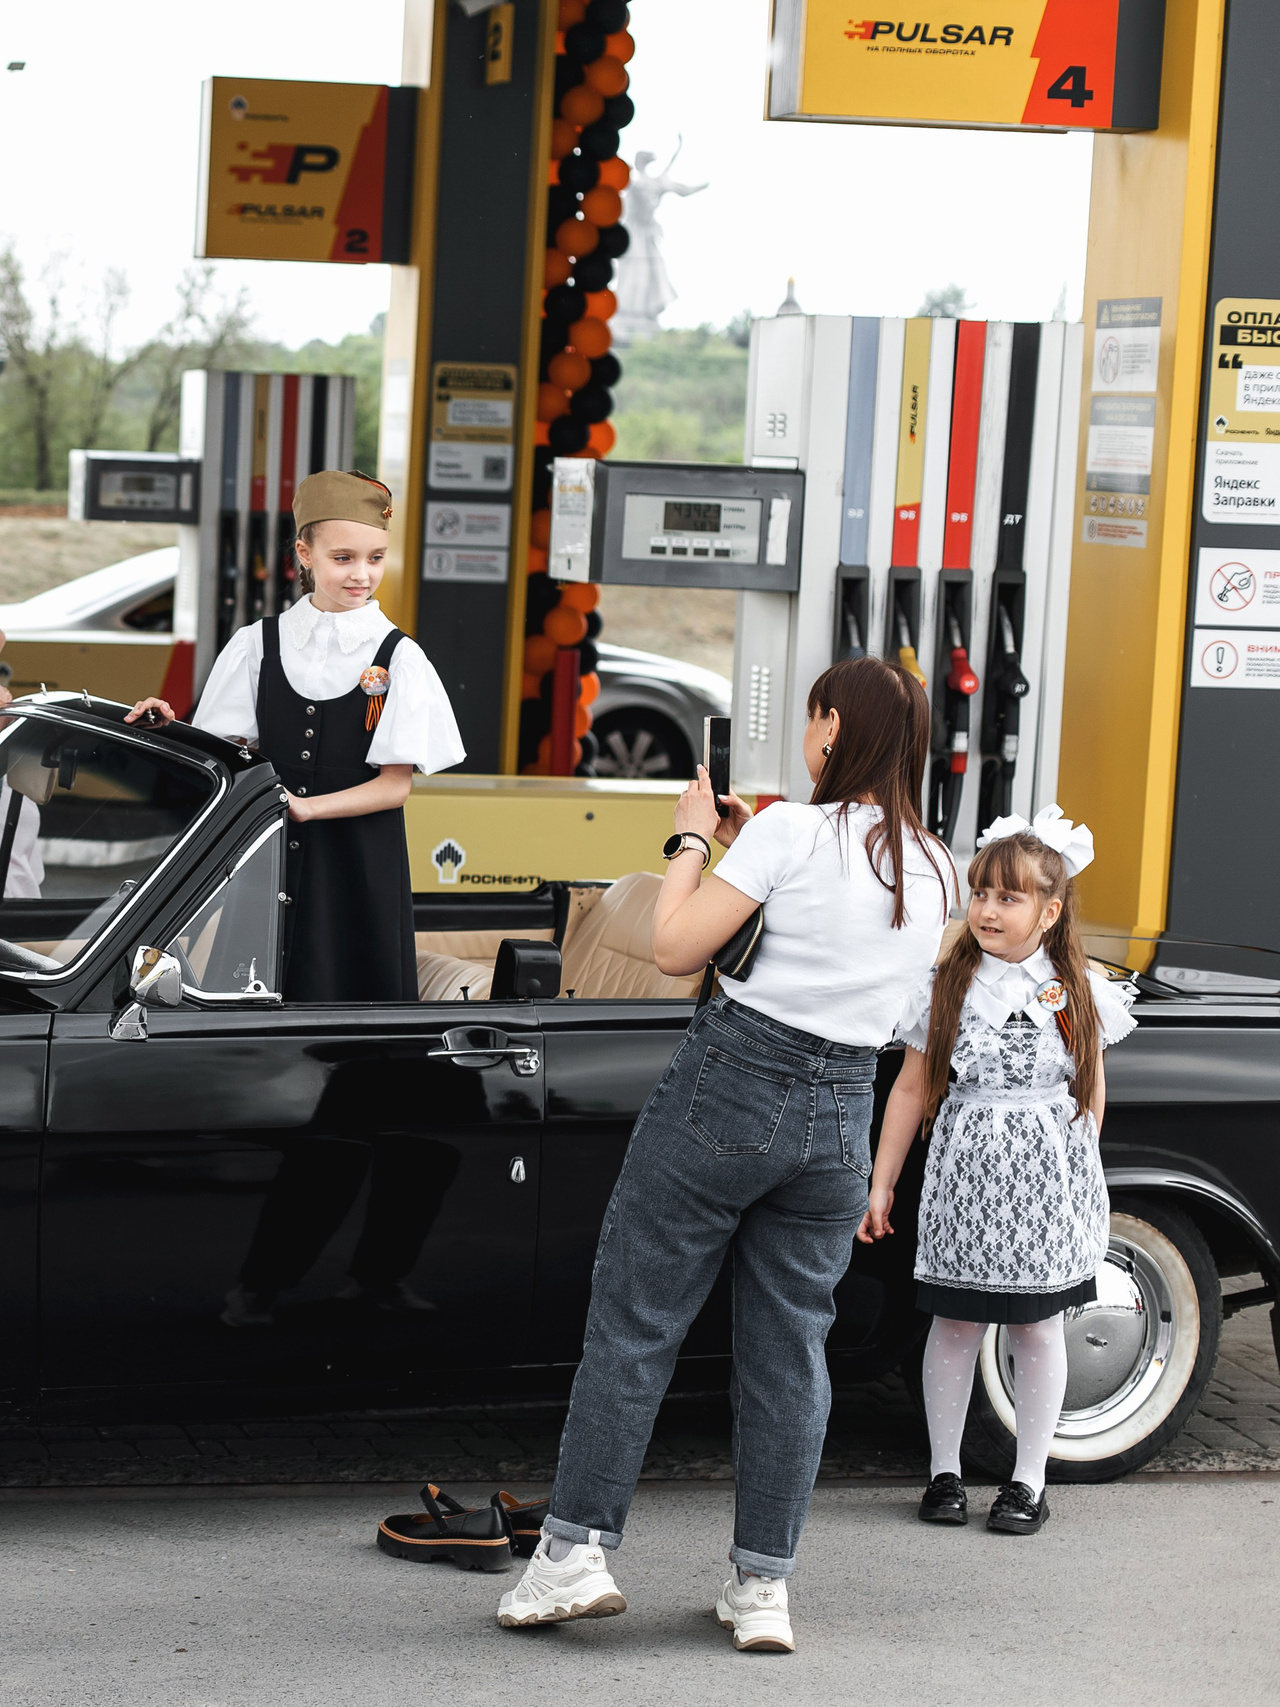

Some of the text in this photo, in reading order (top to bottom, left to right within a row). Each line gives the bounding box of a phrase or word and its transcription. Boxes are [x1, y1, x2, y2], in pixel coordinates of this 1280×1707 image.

[871, 20, 1014, 47] PULSAR
[882, 45, 923, 54] ПОЛНЫХ
[925, 47, 977, 56] ОБОРОТАХ
[1047, 65, 1094, 109] 4
[285, 143, 340, 185] P
[243, 203, 325, 219] PULSAR
[344, 227, 369, 254] 2
[1243, 370, 1273, 381] даже
[910, 384, 919, 435] PULSAR
[1215, 448, 1244, 457] Скачать
[1215, 458, 1259, 467] приложение
[1214, 475, 1261, 491] Яндекс
[1213, 492, 1276, 508] Заправки
[847, 508, 865, 519] 92
[899, 509, 917, 520] 95
[951, 512, 969, 523] 95
[1003, 514, 1023, 525] ДТ
[460, 873, 547, 885] РОСНЕФТЬ
